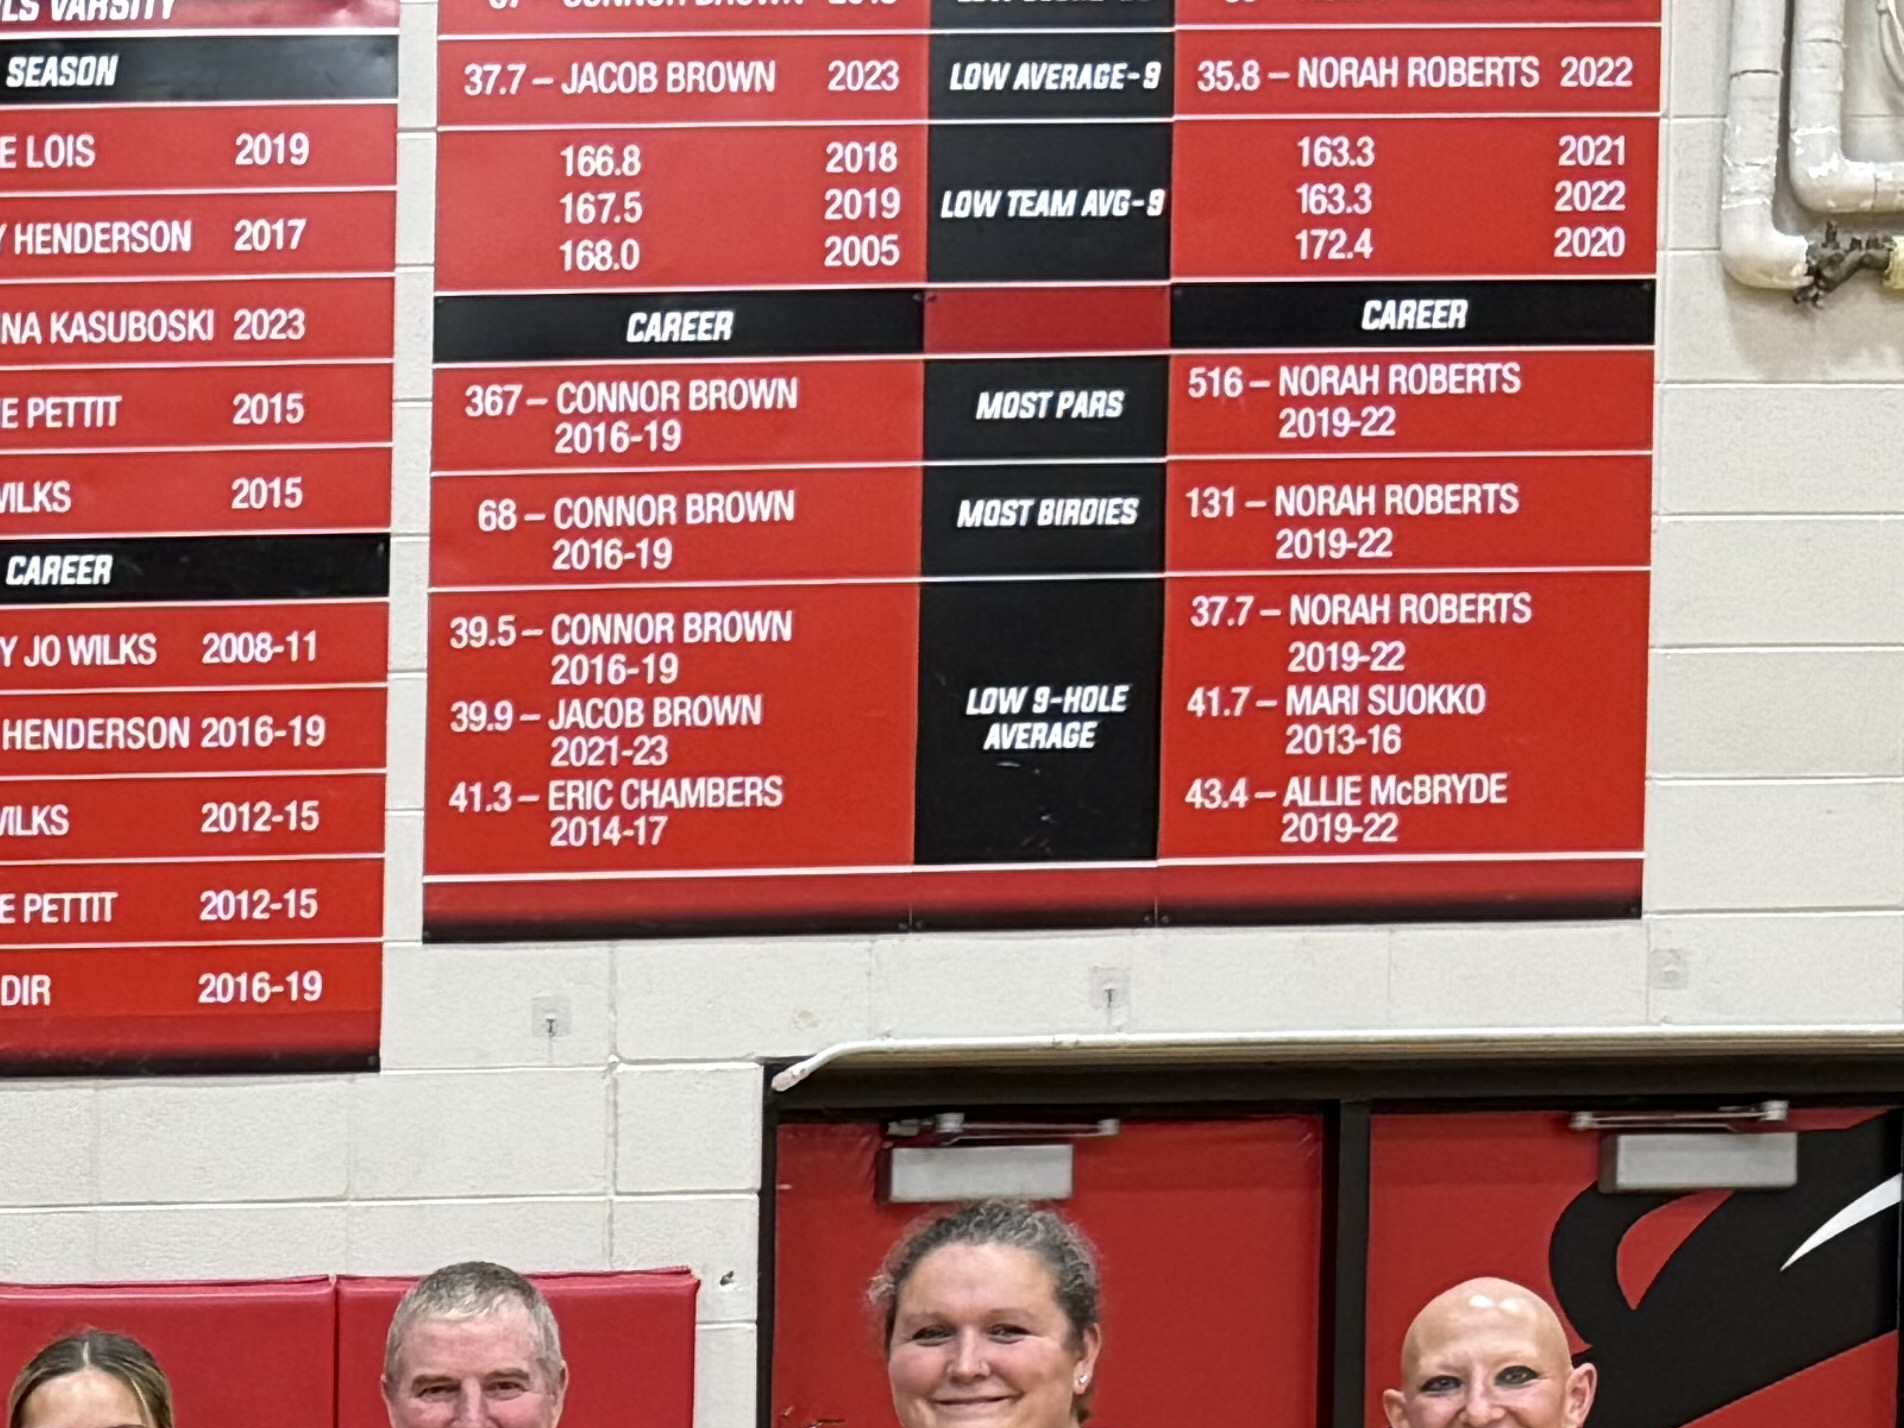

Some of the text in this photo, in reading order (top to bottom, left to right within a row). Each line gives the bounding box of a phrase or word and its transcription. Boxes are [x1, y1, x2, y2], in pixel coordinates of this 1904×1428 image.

[7, 55, 118, 87] SEASON
[465, 60, 899, 95] 37.7 JACOB BROWN 2023
[950, 62, 1161, 90] LOW AVERAGE-9
[1198, 56, 1632, 91] 35.8 NORAH ROBERTS 2022
[27, 134, 95, 167] LOIS
[236, 133, 309, 165] 2019
[561, 142, 897, 176] 166.8 2018
[941, 189, 1165, 218] LOW TEAM AVG-9
[627, 311, 734, 342] CAREER
[1362, 299, 1468, 329] CAREER
[976, 390, 1125, 419] MOST PARS
[477, 490, 794, 532] 68 CONNOR BROWN
[957, 498, 1139, 527] MOST BIRDIES
[6, 555, 113, 585] CAREER
[966, 685, 1129, 714] LOW 9-HOLE
[984, 721, 1097, 749] AVERAGE
[1185, 773, 1507, 808] 43.4 ALLIE McBRYDE
[1282, 813, 1398, 842] 2019-22
[1, 975, 50, 1005] DIR
[199, 971, 322, 1003] 2016-19
